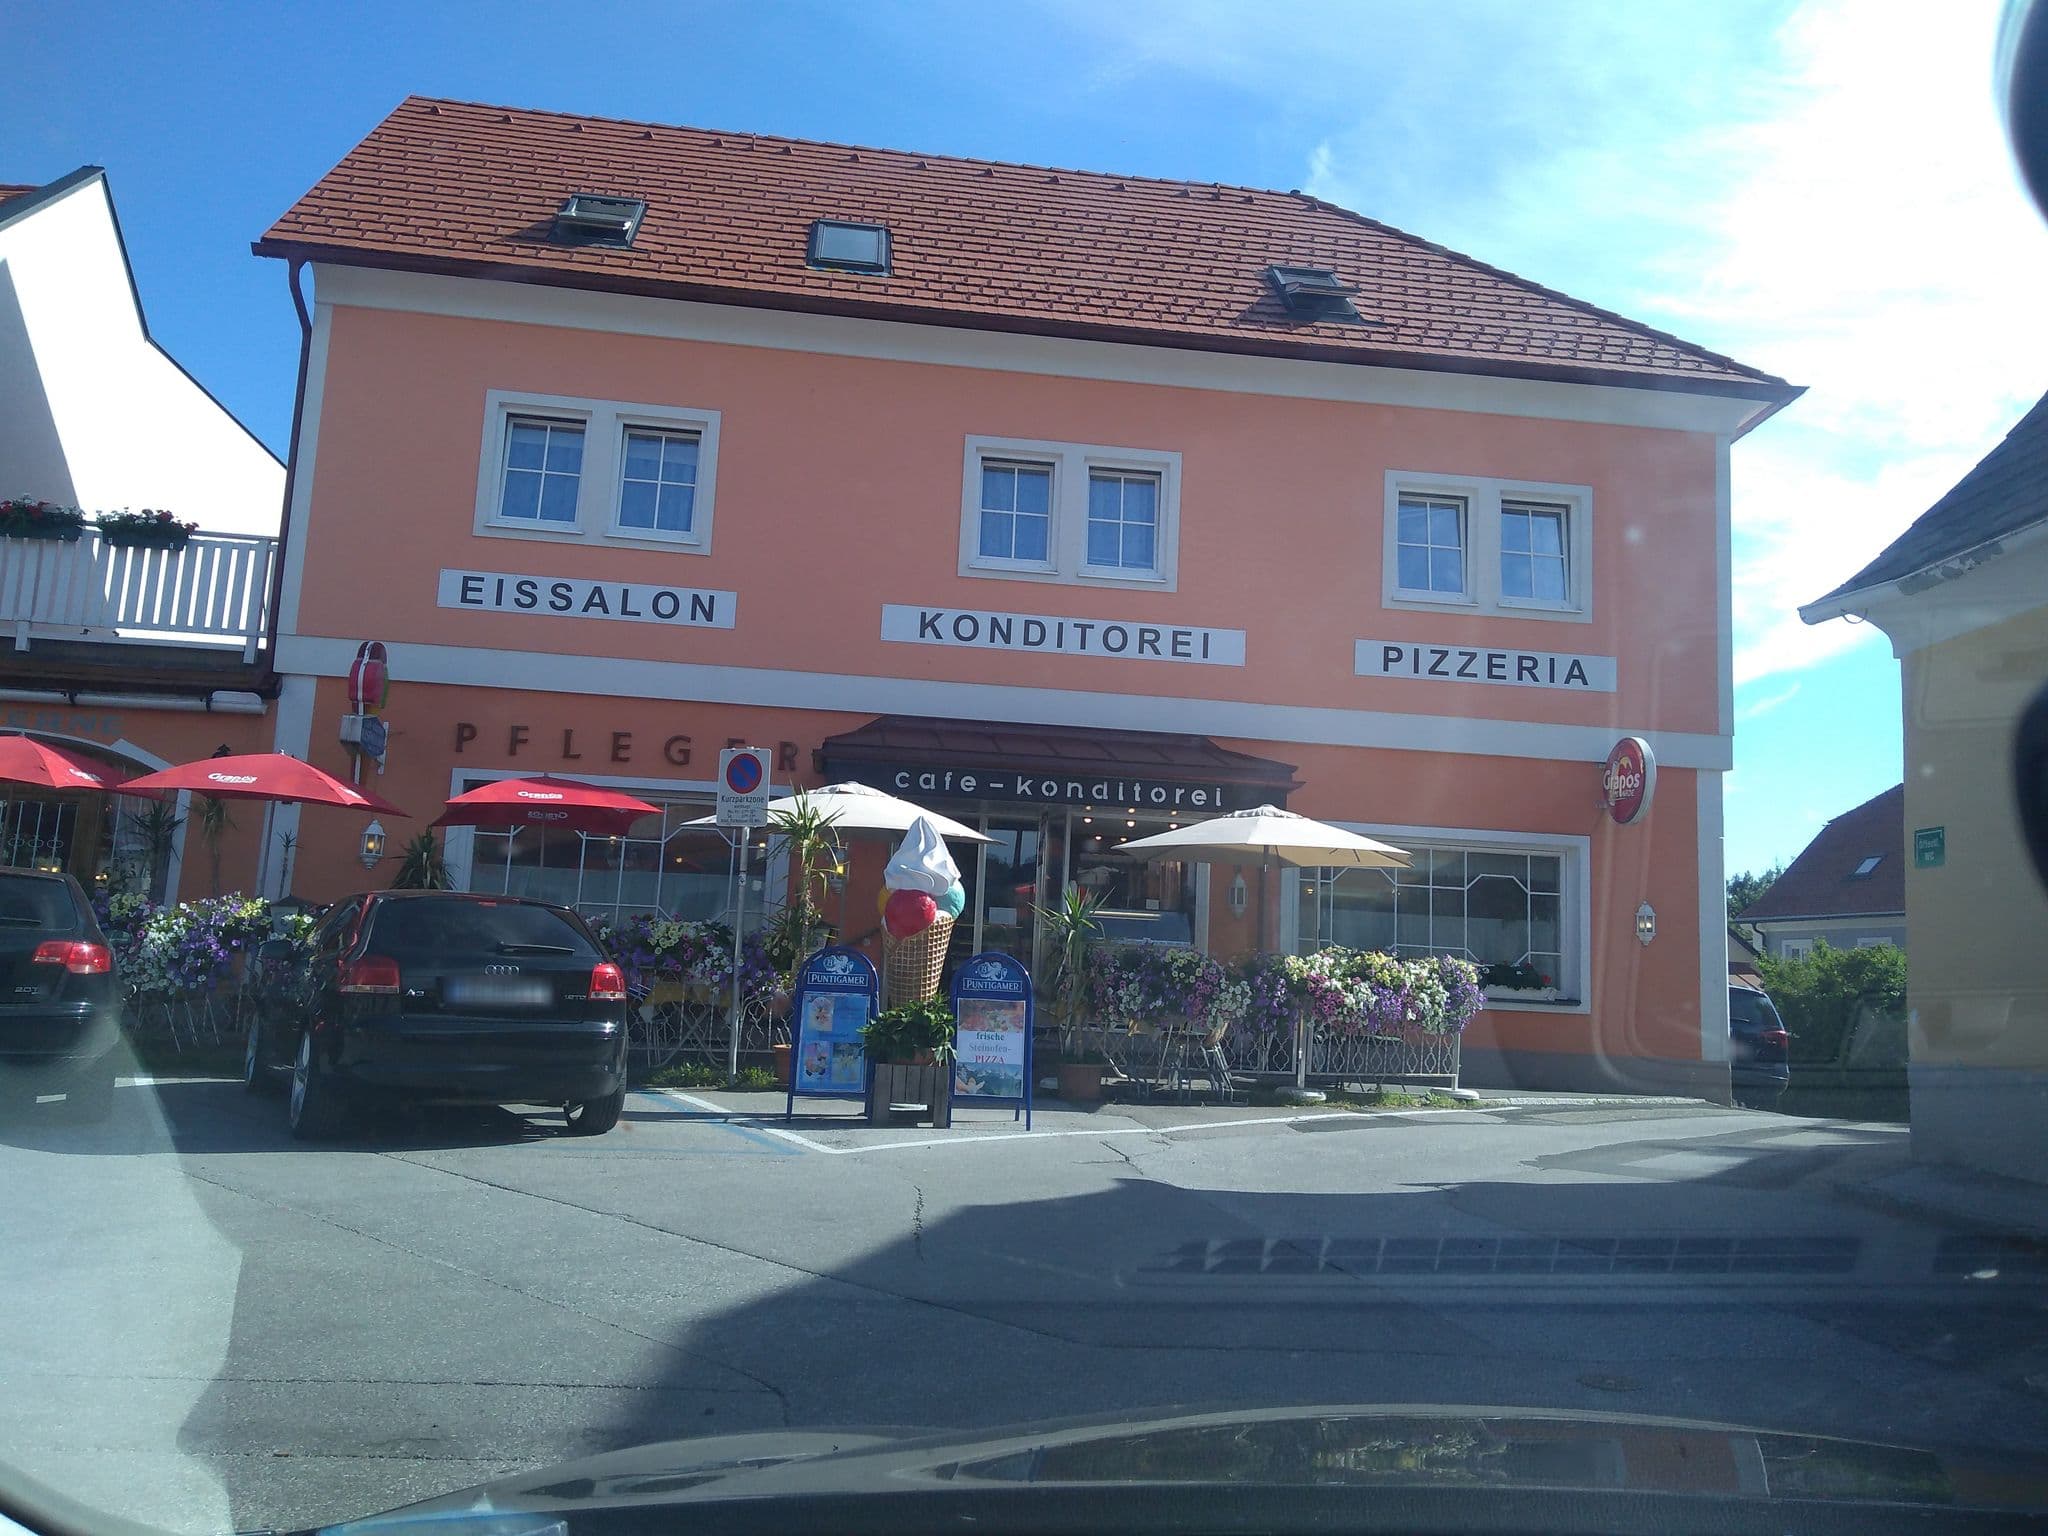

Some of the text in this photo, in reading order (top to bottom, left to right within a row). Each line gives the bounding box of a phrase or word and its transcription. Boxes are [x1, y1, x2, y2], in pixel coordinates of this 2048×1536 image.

[459, 575, 716, 623] EISSALON
[918, 611, 1210, 659] KONDITOREI
[1382, 645, 1589, 686] PIZZERIA
[1603, 770, 1641, 797] Grapos
[721, 795, 765, 805] Kurzparkzone
[810, 973, 865, 985] PUNTIGAMER
[965, 979, 1020, 991] PUNTIGAMER
[975, 1032, 1005, 1041] frische
[974, 1055, 1006, 1064] PIZZA
